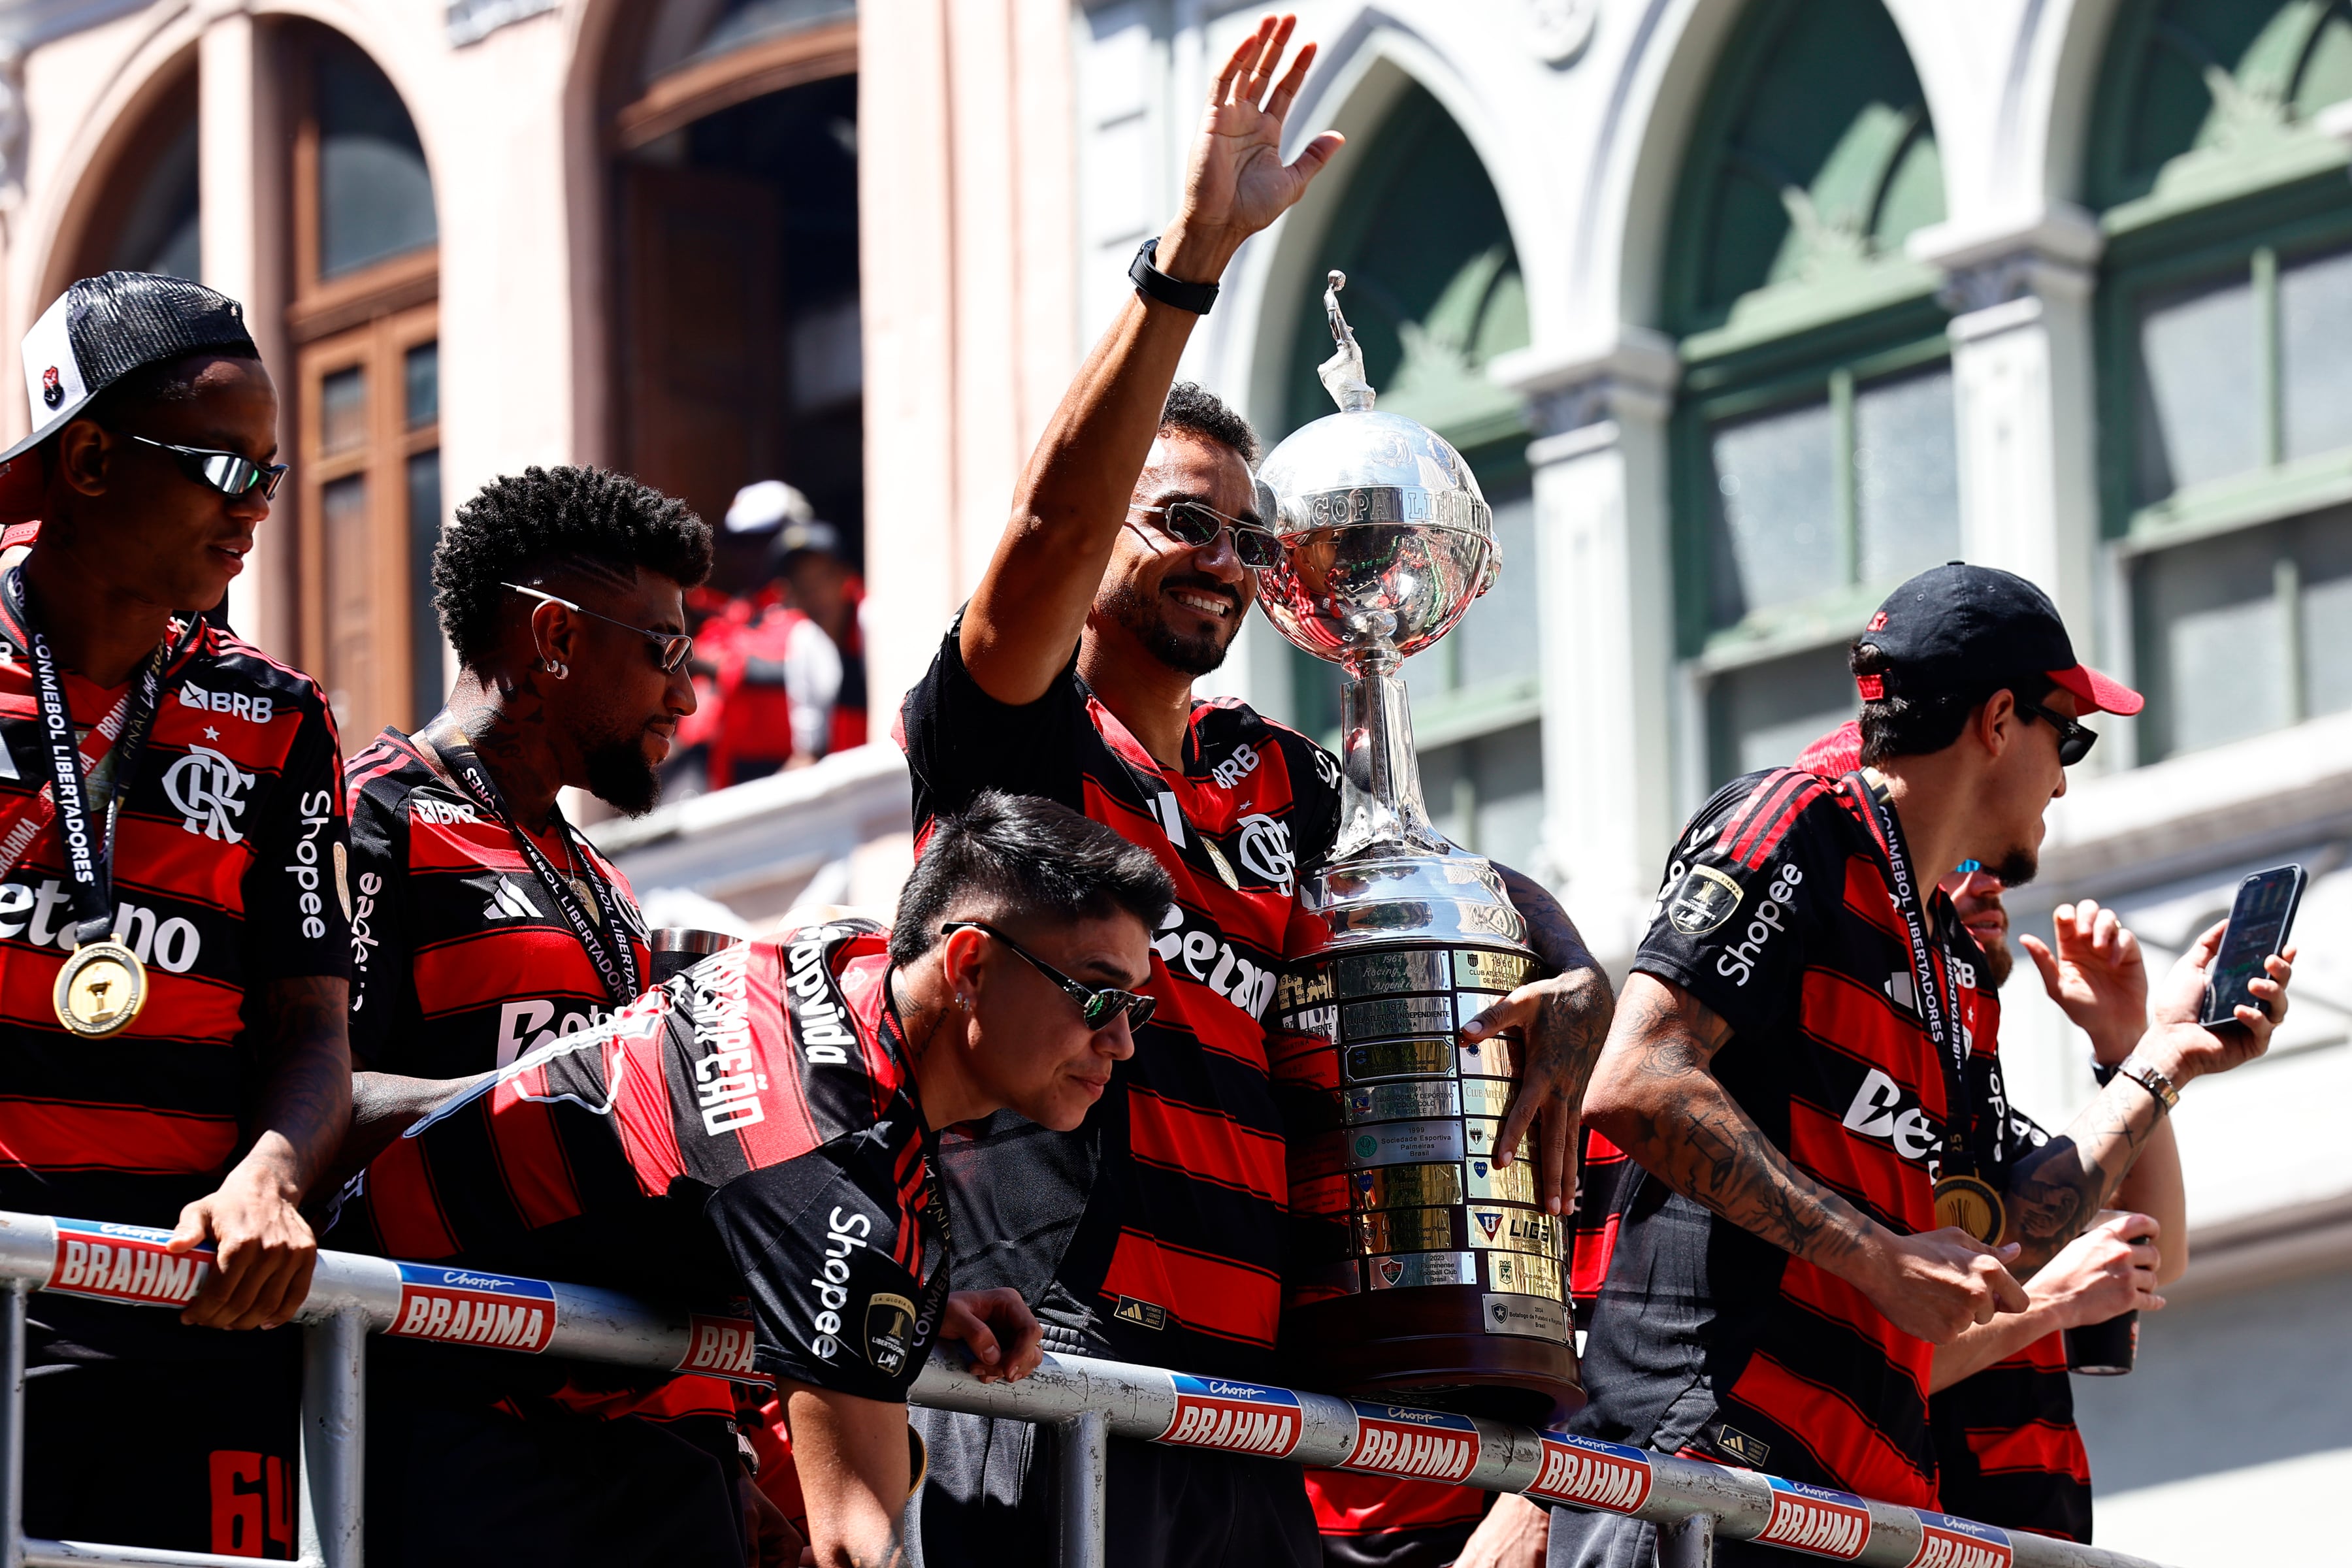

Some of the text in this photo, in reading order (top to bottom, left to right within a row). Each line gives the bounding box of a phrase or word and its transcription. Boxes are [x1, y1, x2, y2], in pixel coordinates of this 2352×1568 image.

[1311, 491, 1390, 526] COPA
[210, 692, 272, 724] BRB
[35, 633, 67, 740] CONMEBOL
[53, 745, 94, 883] LIBERTADORES
[1212, 743, 1260, 789] BRB
[285, 789, 331, 939] Shopee
[1716, 863, 1803, 987] Shopee
[561, 896, 629, 1006] LIBERTADORE
[1492, 958, 1512, 968] 1960
[1363, 967, 1397, 978] Racing
[1906, 911, 1944, 1043] LIBERTADORES
[1346, 1017, 1365, 1026] CLUB
[1397, 1010, 1450, 1020] INDEPENDIENTE
[1386, 1003, 1409, 1011] 1975
[443, 1271, 515, 1290] Chopp
[812, 1205, 871, 1360] Shopee
[399, 1295, 544, 1348] BRAHMA
[1209, 1380, 1266, 1399] Chopp
[1179, 1405, 1293, 1454] BRAHMA
[1388, 1407, 1444, 1424] Chopp
[1354, 1428, 1469, 1479] BRAHMA
[1565, 1435, 1618, 1453] Chopp
[1539, 1450, 1645, 1511] BRAHMA
[1793, 1482, 1840, 1500] Chopp
[1765, 1501, 1864, 1557] BRAHMA
[1943, 1516, 1986, 1535] Chopp
